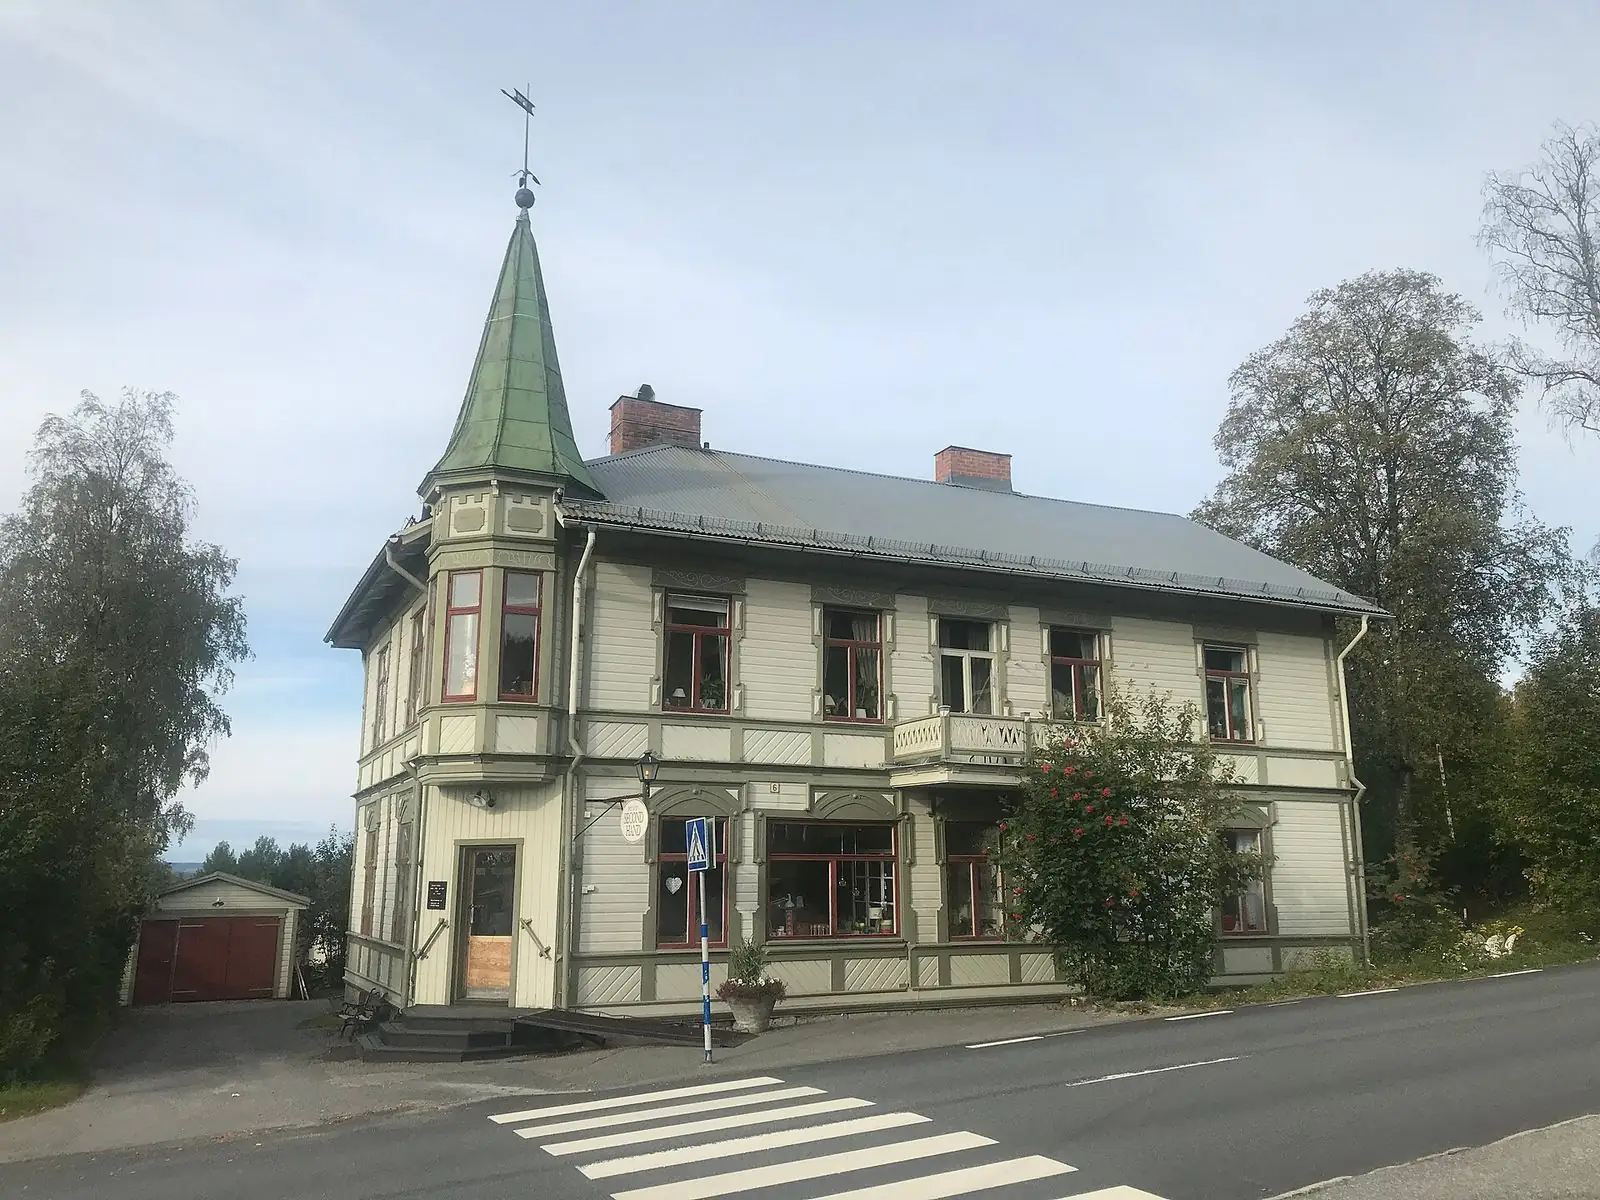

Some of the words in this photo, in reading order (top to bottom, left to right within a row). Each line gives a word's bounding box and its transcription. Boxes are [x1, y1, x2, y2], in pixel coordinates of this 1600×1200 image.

[772, 783, 778, 792] 6
[623, 811, 645, 824] SECOND
[625, 824, 642, 837] HAND
